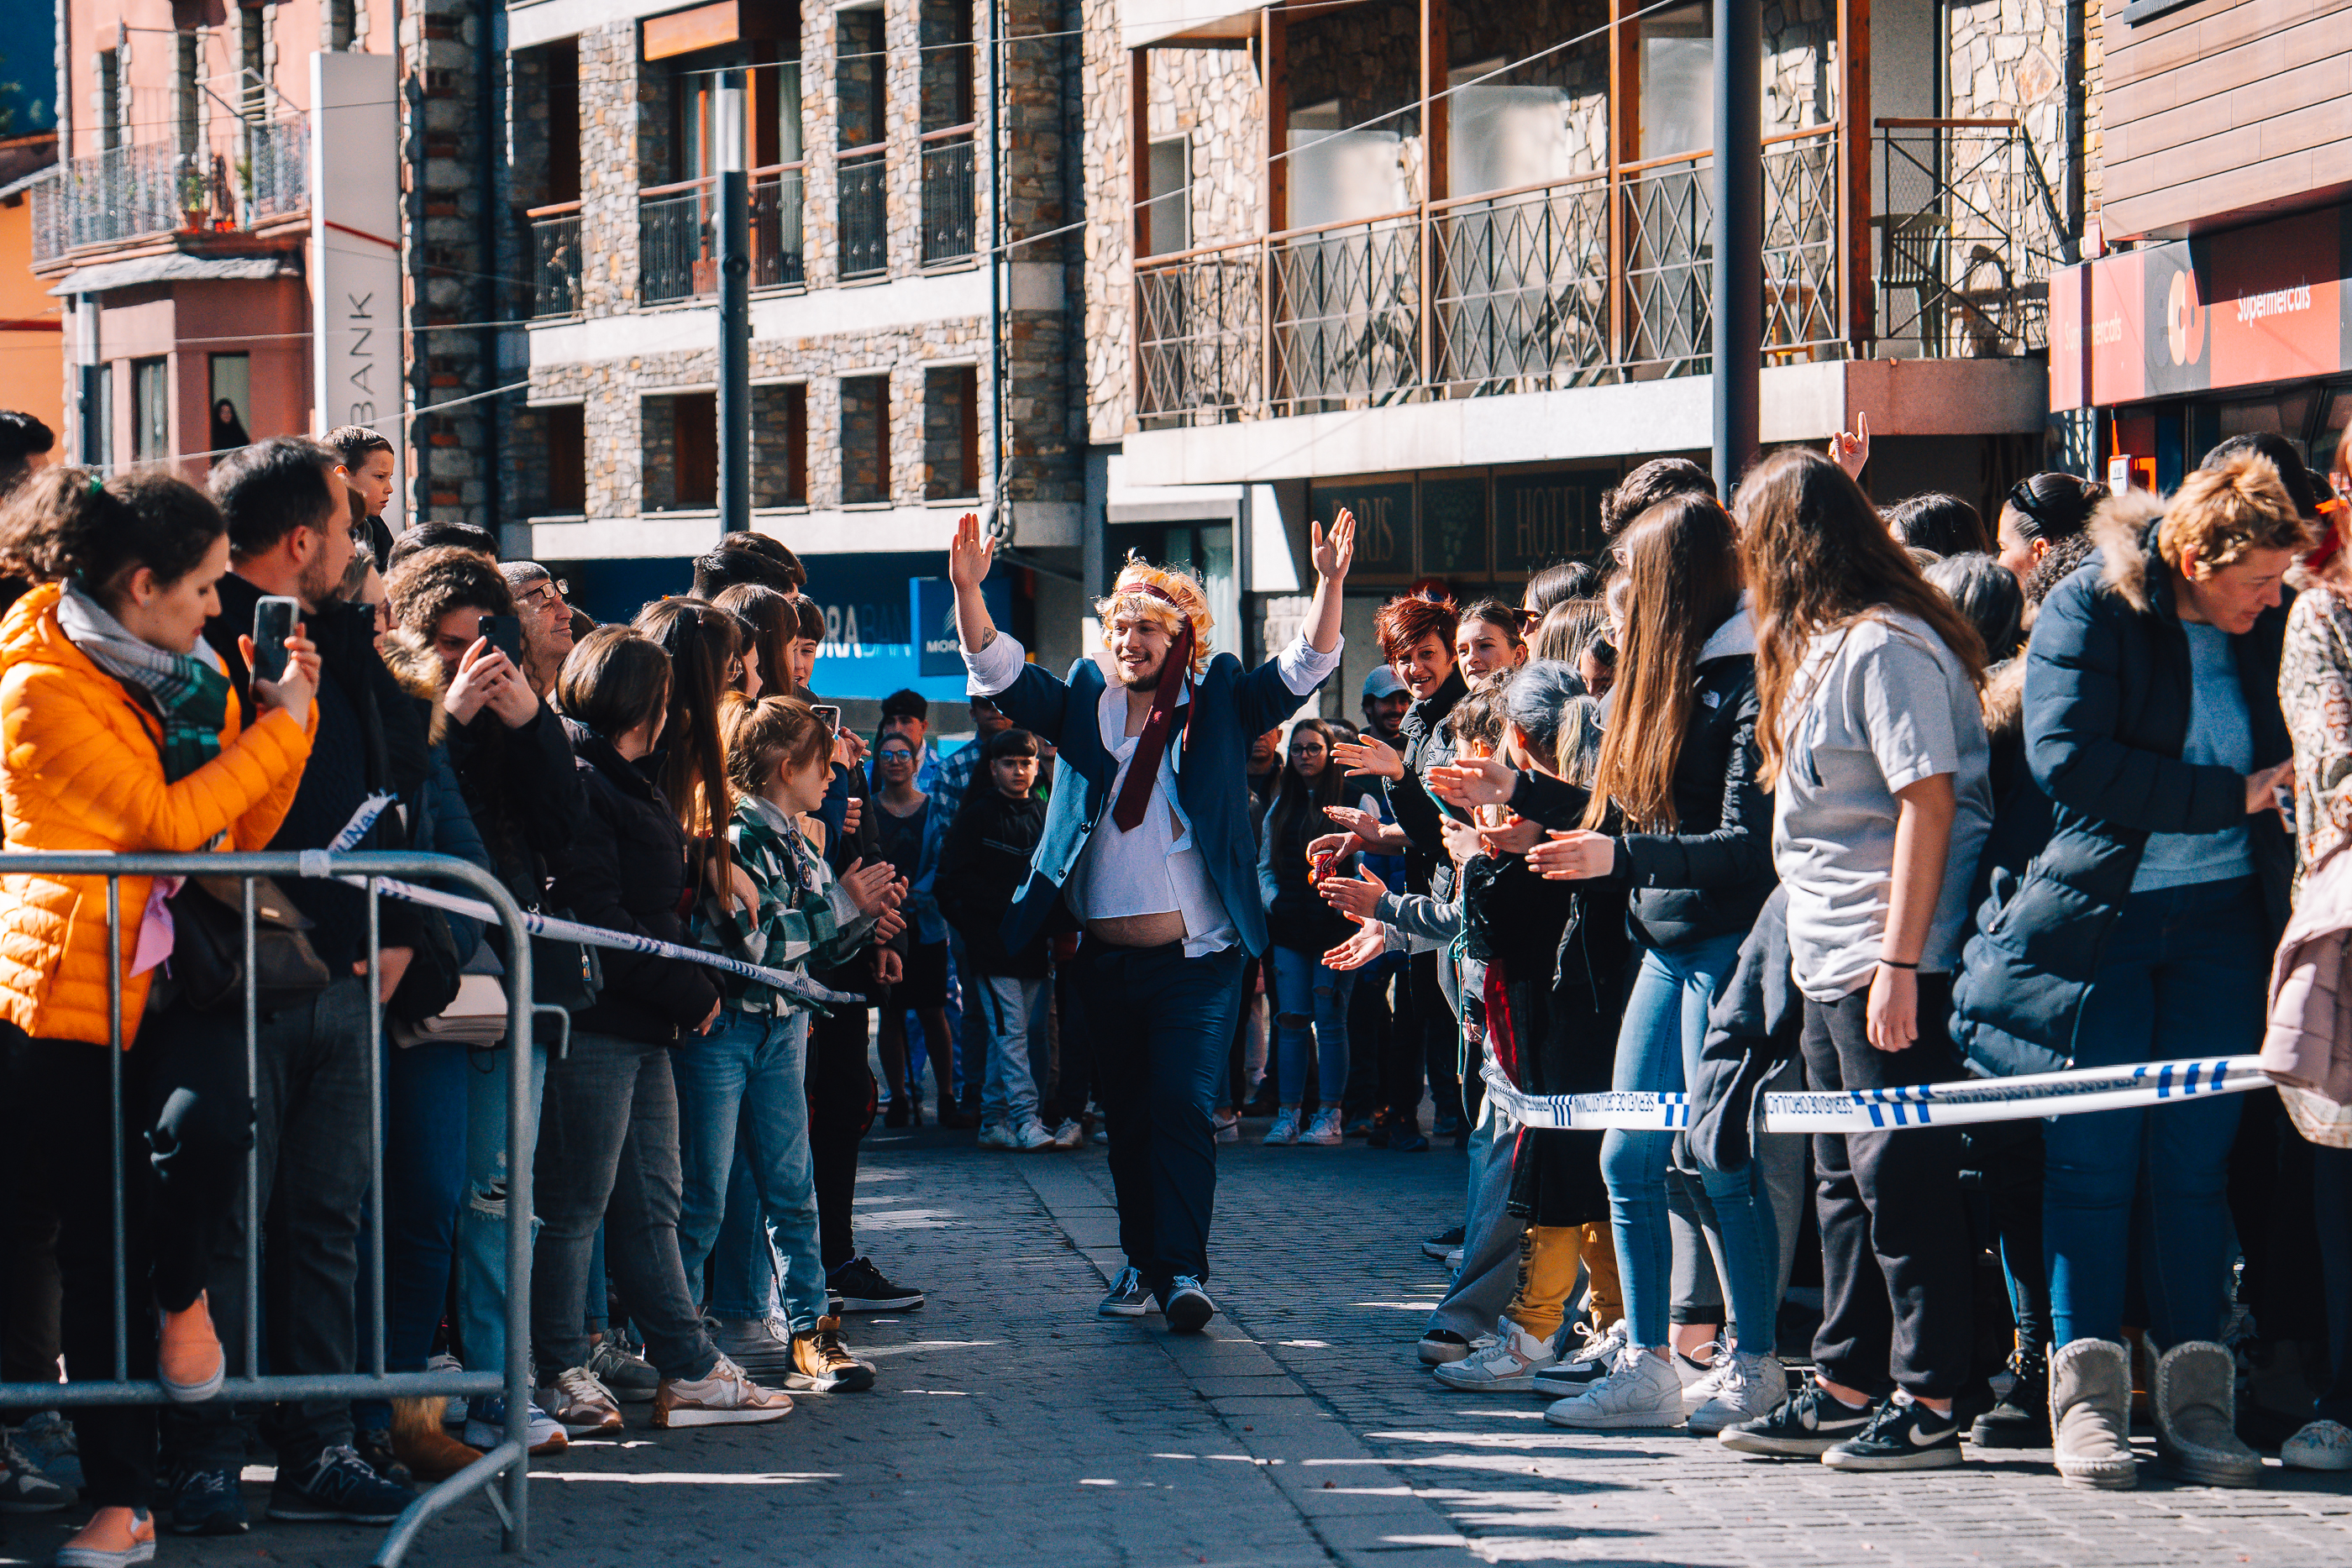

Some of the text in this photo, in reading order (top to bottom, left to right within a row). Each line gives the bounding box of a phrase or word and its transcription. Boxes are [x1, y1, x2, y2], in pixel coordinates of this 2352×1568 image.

[2237, 275, 2310, 328] Supermercats
[2065, 311, 2121, 356] Supercats
[1331, 496, 1394, 561] RIS
[1515, 485, 1594, 558] HOTEL
